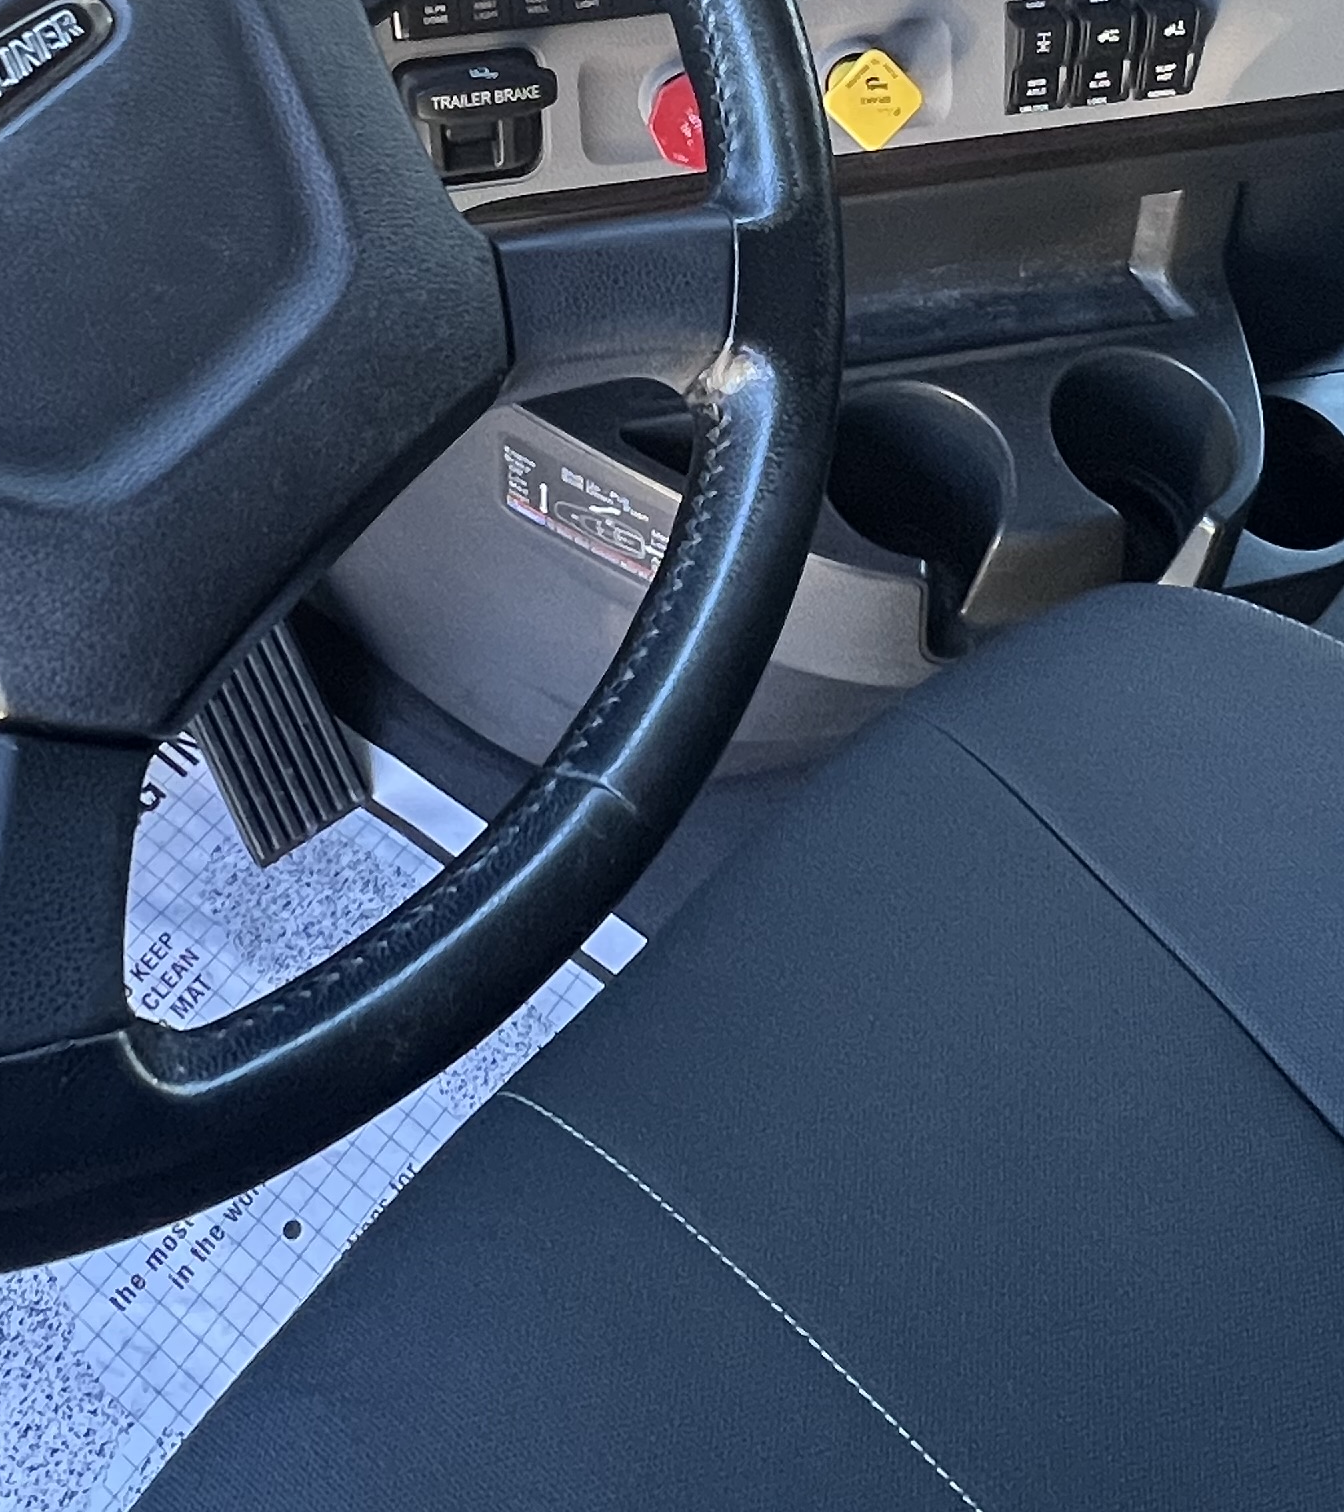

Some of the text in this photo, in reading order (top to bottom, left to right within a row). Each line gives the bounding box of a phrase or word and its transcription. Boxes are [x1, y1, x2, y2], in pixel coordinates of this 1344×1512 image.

[431, 84, 541, 110] TRAILER BRAKE
[129, 932, 173, 983] KEEP
[141, 948, 200, 1011] CLEAN
[169, 973, 212, 1020] MAT
[168, 1264, 195, 1290] in
[190, 1224, 226, 1262] the
[109, 1273, 147, 1312] the
